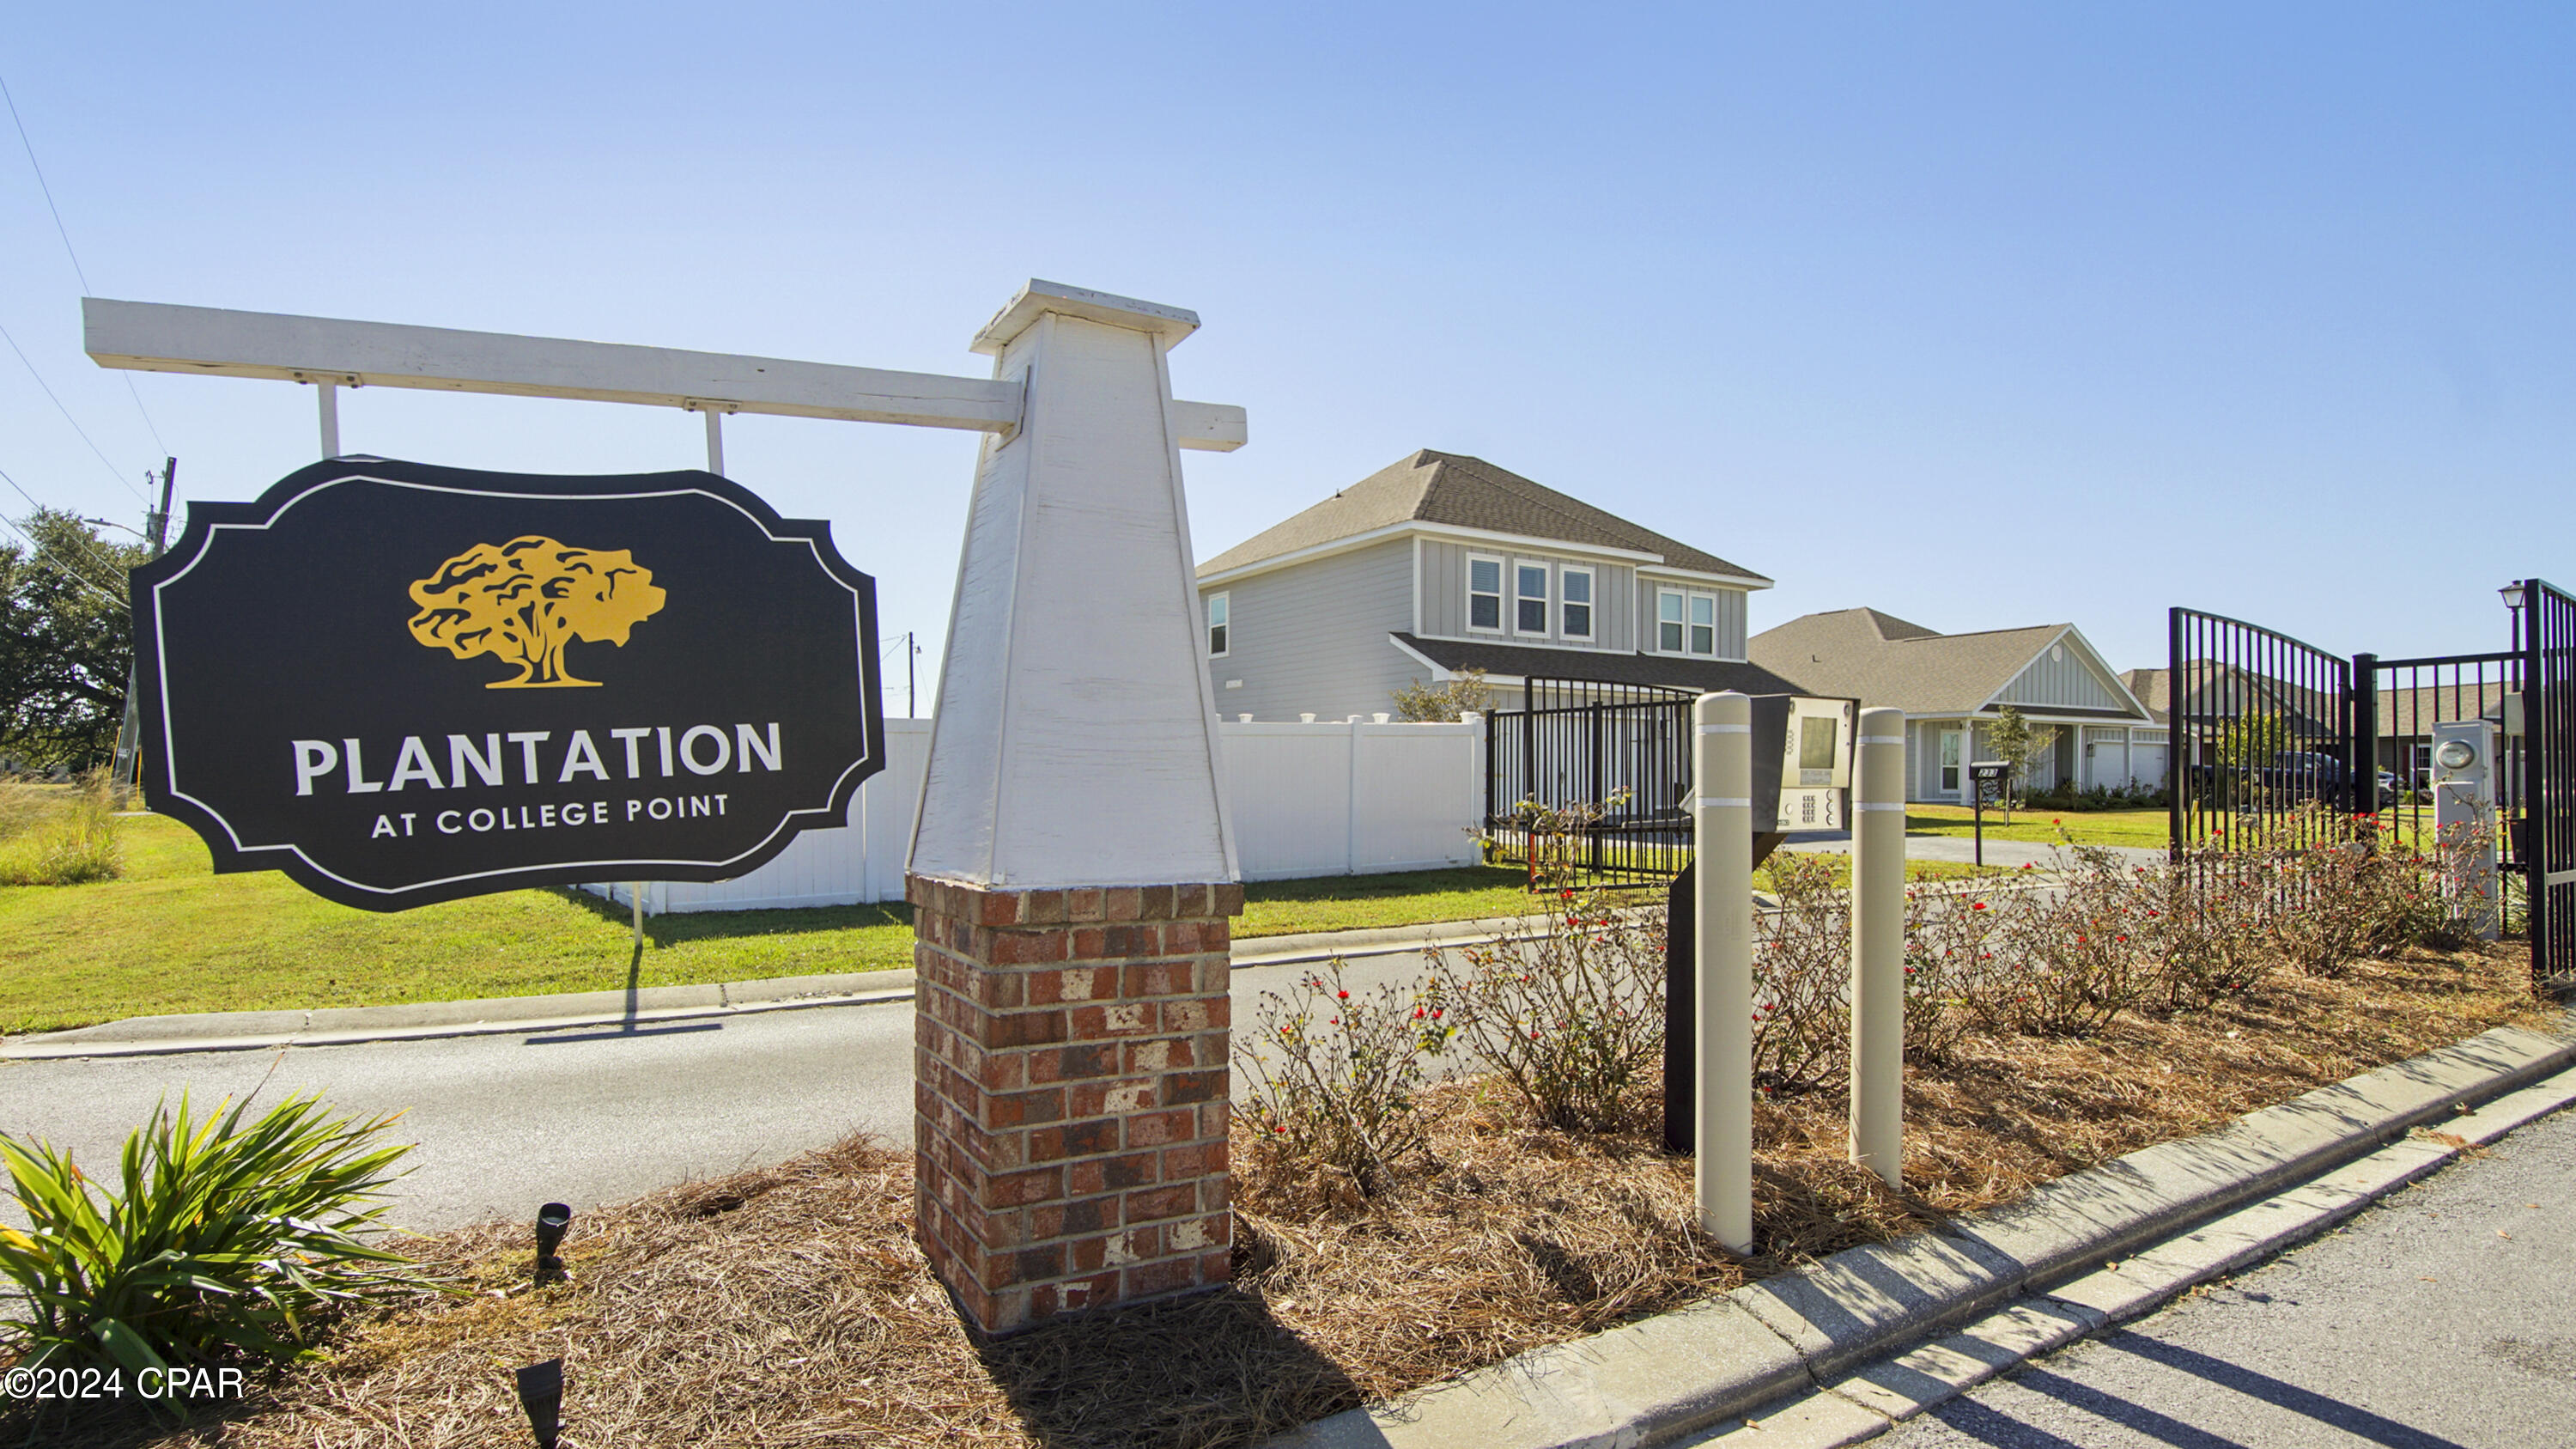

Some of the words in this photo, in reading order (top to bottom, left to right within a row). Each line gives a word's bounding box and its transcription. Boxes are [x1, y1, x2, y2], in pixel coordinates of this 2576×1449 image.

[291, 722, 782, 796] PLANTATION
[371, 813, 417, 838] AT
[436, 801, 609, 834] COLLEGE
[627, 794, 729, 822] POINT
